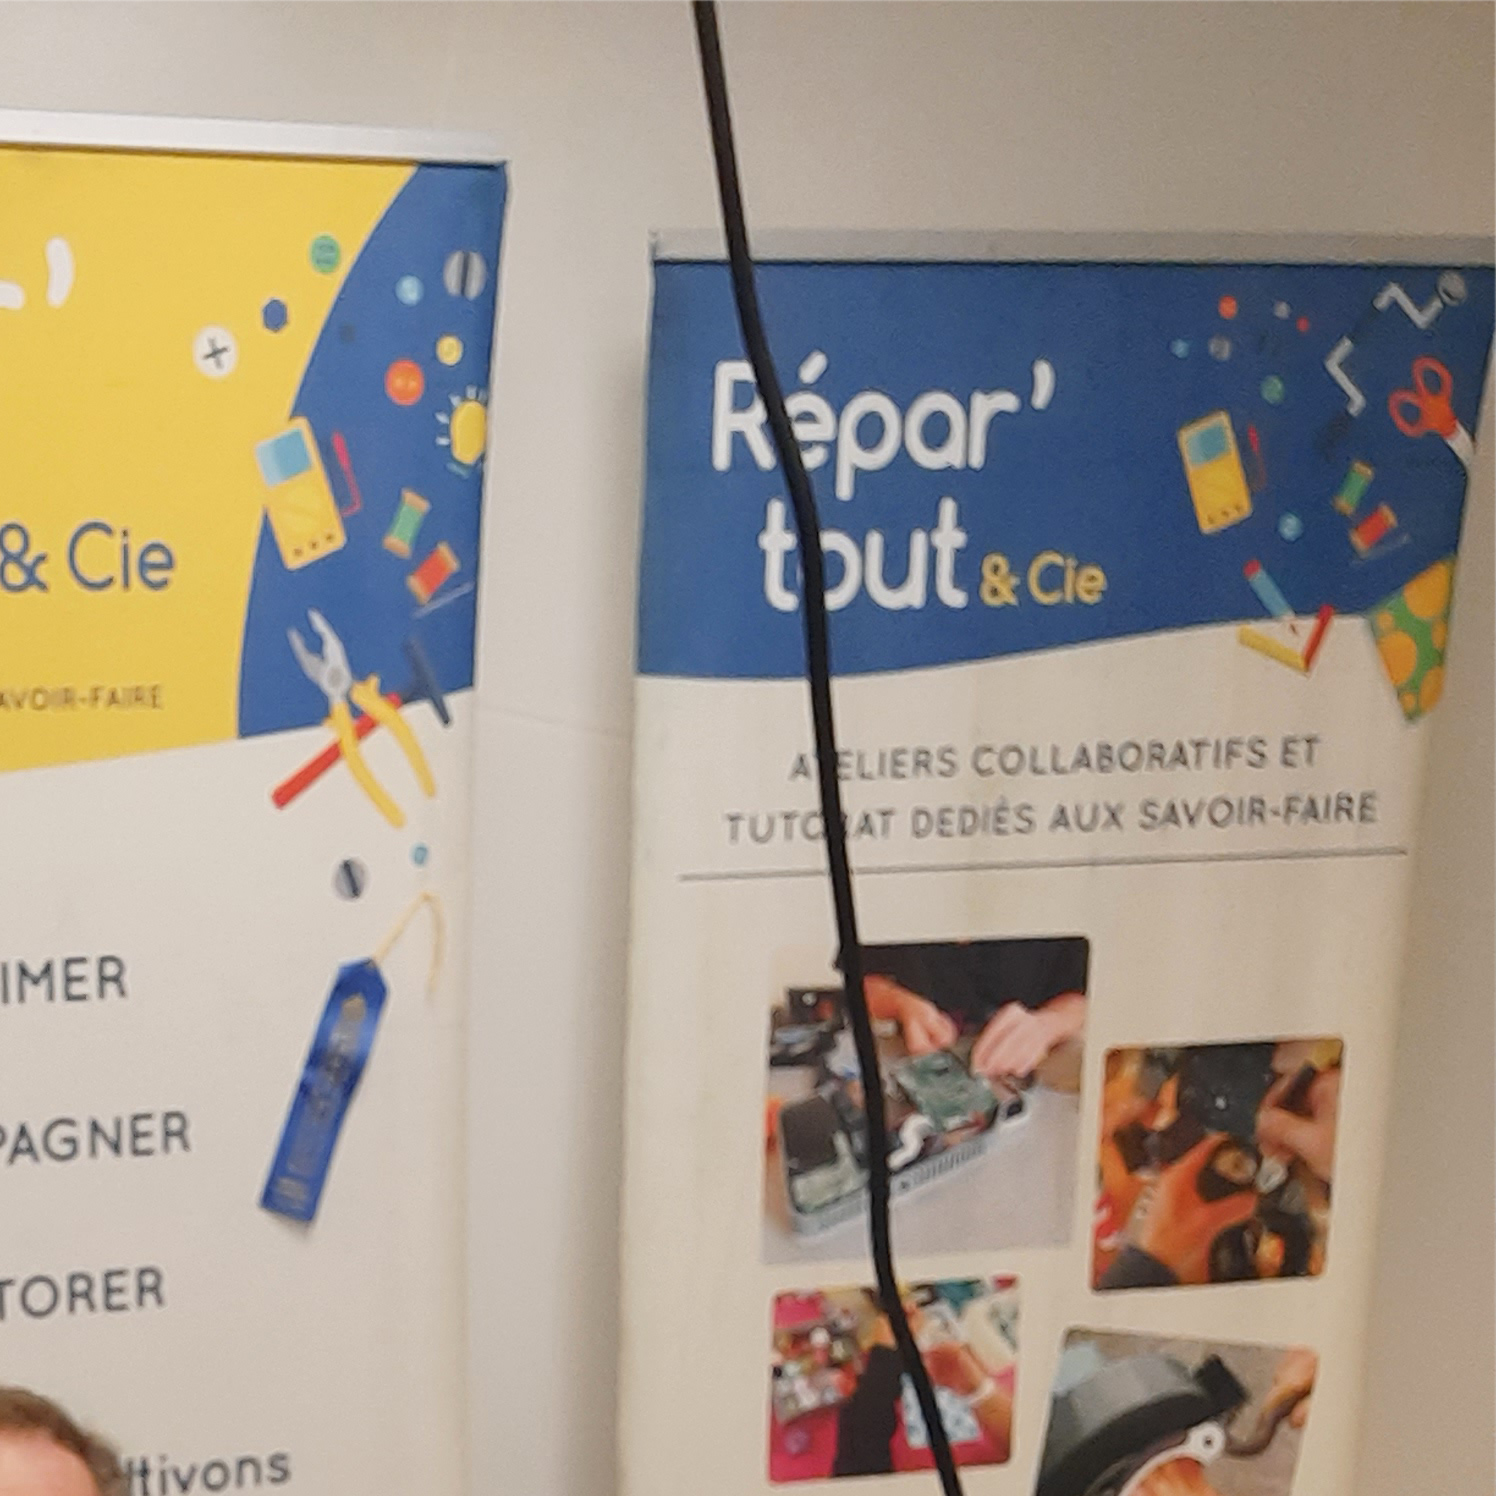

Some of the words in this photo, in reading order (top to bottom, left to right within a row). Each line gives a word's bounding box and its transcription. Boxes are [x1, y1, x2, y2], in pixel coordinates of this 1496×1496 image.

[712, 350, 1056, 501] Répar'
[67, 521, 175, 592] Cie
[979, 551, 1021, 607] &
[1027, 549, 1108, 605] Cie
[788, 746, 958, 781] AELIERS
[971, 738, 1268, 777] COLLABORATIFS
[1280, 734, 1322, 768] ET
[725, 807, 895, 844] TUTOAT
[1049, 802, 1124, 833] AUX
[1138, 790, 1377, 829] SAVOIR-FAIRE
